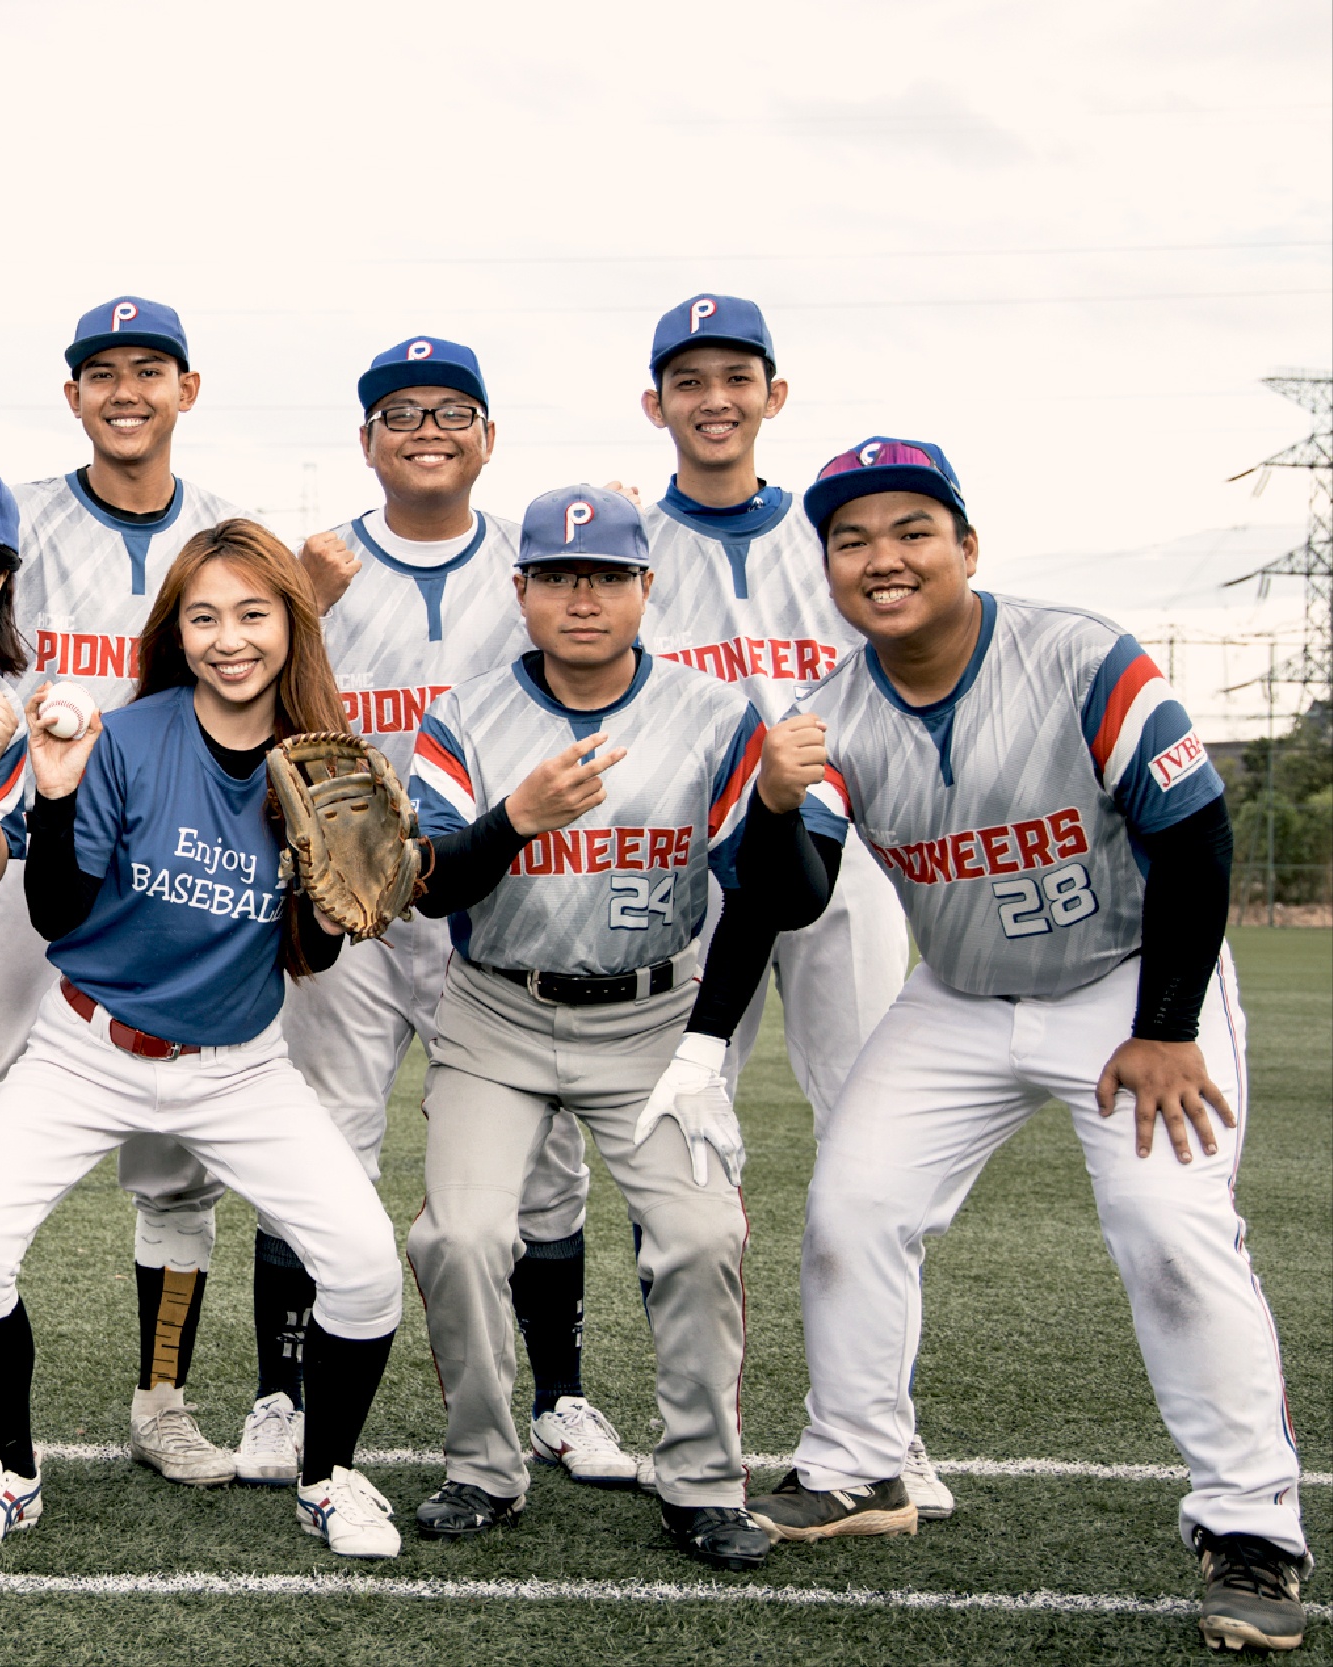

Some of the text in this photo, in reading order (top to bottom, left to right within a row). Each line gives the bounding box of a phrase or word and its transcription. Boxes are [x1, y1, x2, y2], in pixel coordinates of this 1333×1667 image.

[112, 302, 139, 332] P
[690, 297, 718, 334] P
[564, 501, 595, 545] P
[35, 629, 142, 679] PION
[656, 636, 838, 684] ONEERS
[339, 684, 454, 735] PION
[174, 827, 257, 884] Enjoy
[509, 825, 693, 877] ONEERS
[609, 872, 679, 931] 24
[991, 862, 1099, 940] 28
